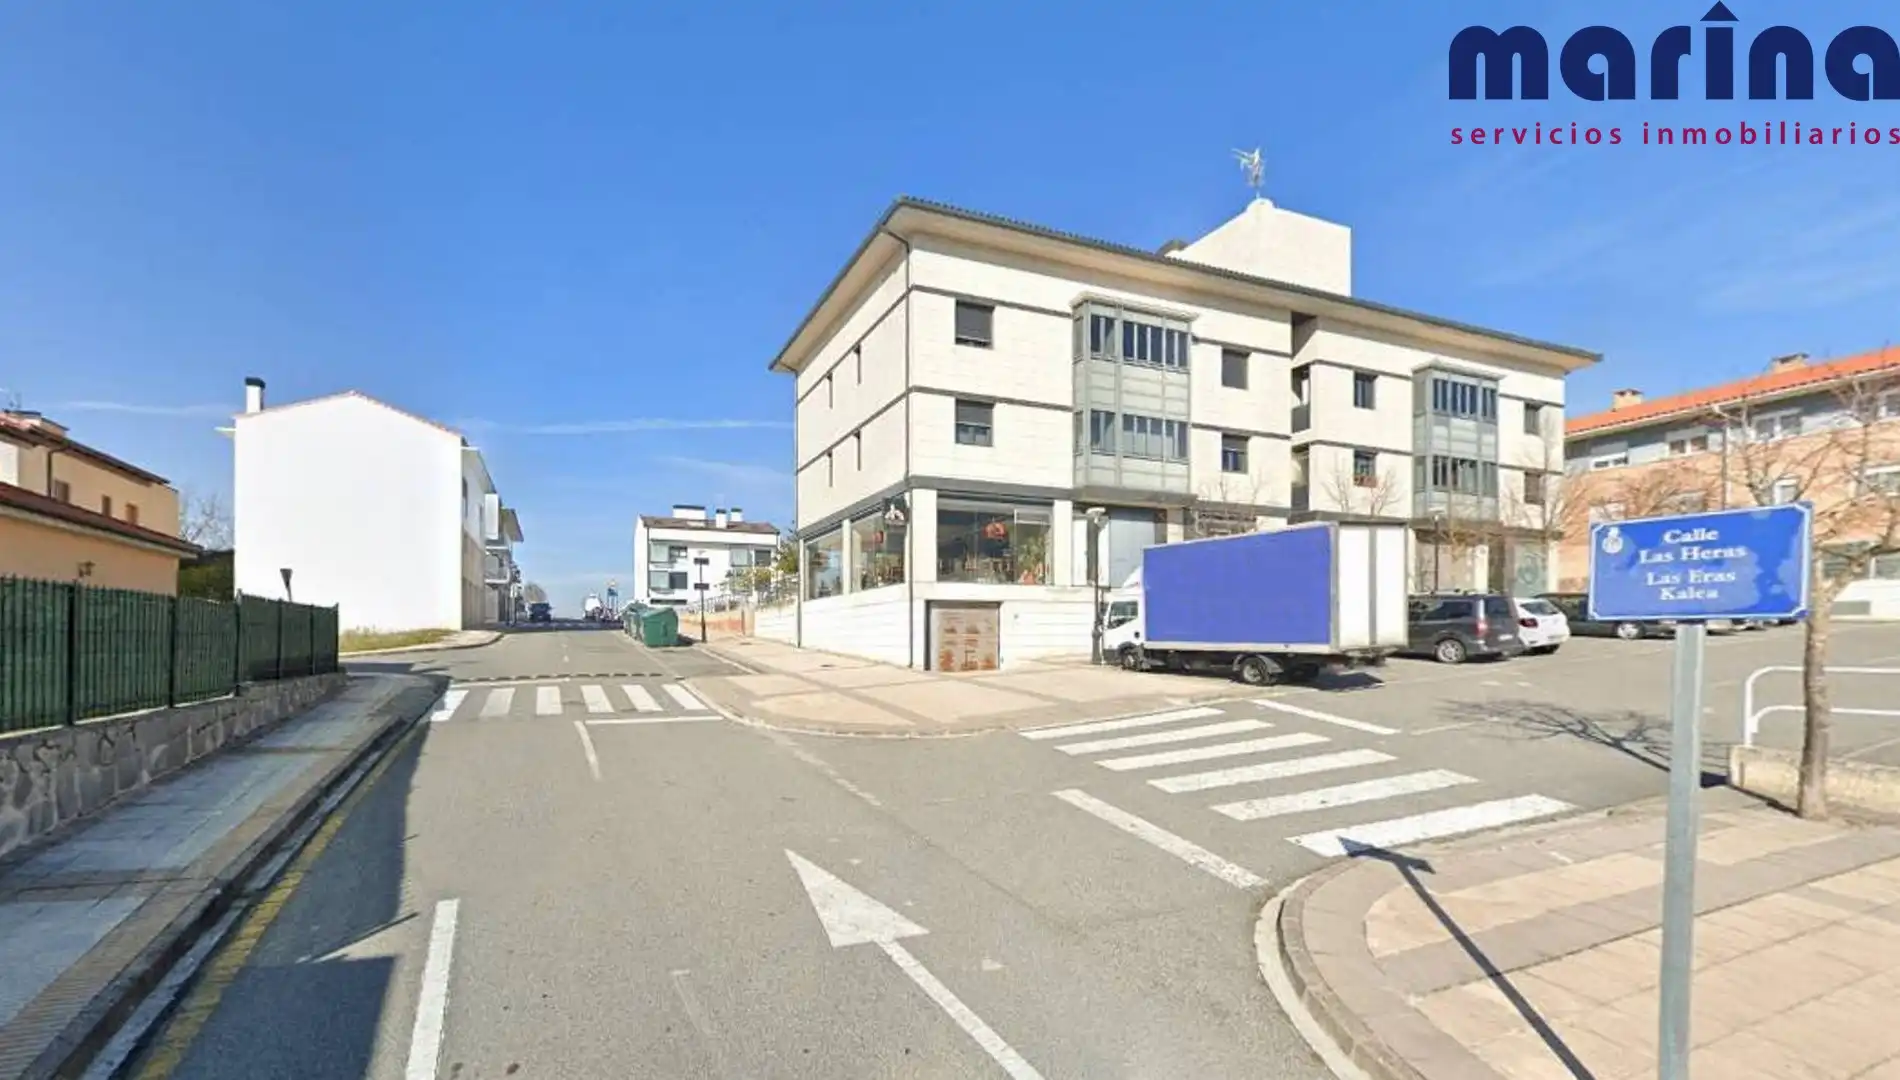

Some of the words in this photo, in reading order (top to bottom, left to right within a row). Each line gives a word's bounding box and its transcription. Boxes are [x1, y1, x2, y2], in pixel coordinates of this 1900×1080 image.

[1663, 527, 1719, 544] Calle
[1638, 548, 1675, 564] Las
[1680, 544, 1748, 561] Heras
[1646, 571, 1681, 586] Las
[1688, 567, 1736, 583] Eras
[1659, 586, 1719, 600] Kalea
